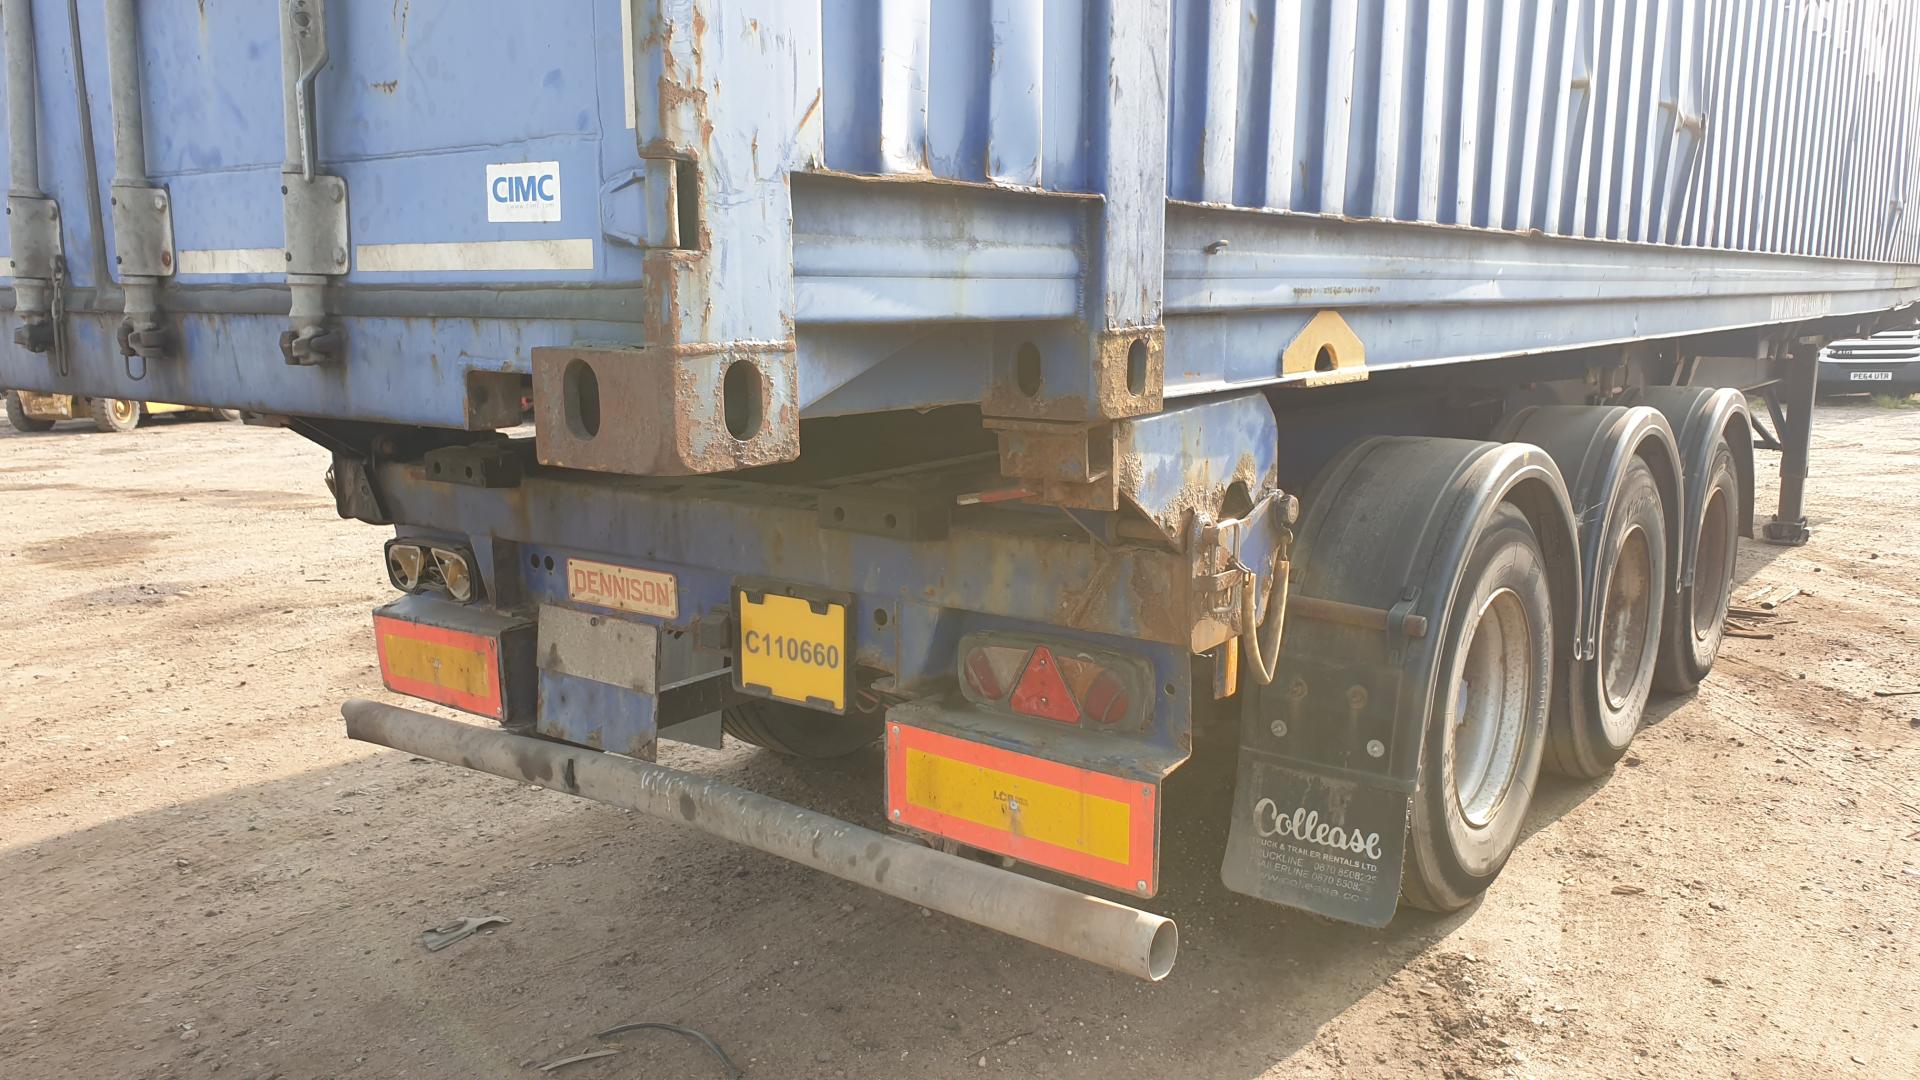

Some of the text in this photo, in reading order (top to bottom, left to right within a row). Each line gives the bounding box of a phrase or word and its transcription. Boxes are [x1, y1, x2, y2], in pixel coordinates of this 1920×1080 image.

[492, 174, 554, 203] CIMC
[574, 568, 670, 607] DENNISON
[745, 630, 839, 669] C110660
[1253, 798, 1382, 860] Collease
[1279, 843, 1286, 852] &
[1287, 844, 1321, 859] TRAILER
[1322, 853, 1360, 868] RENTALS
